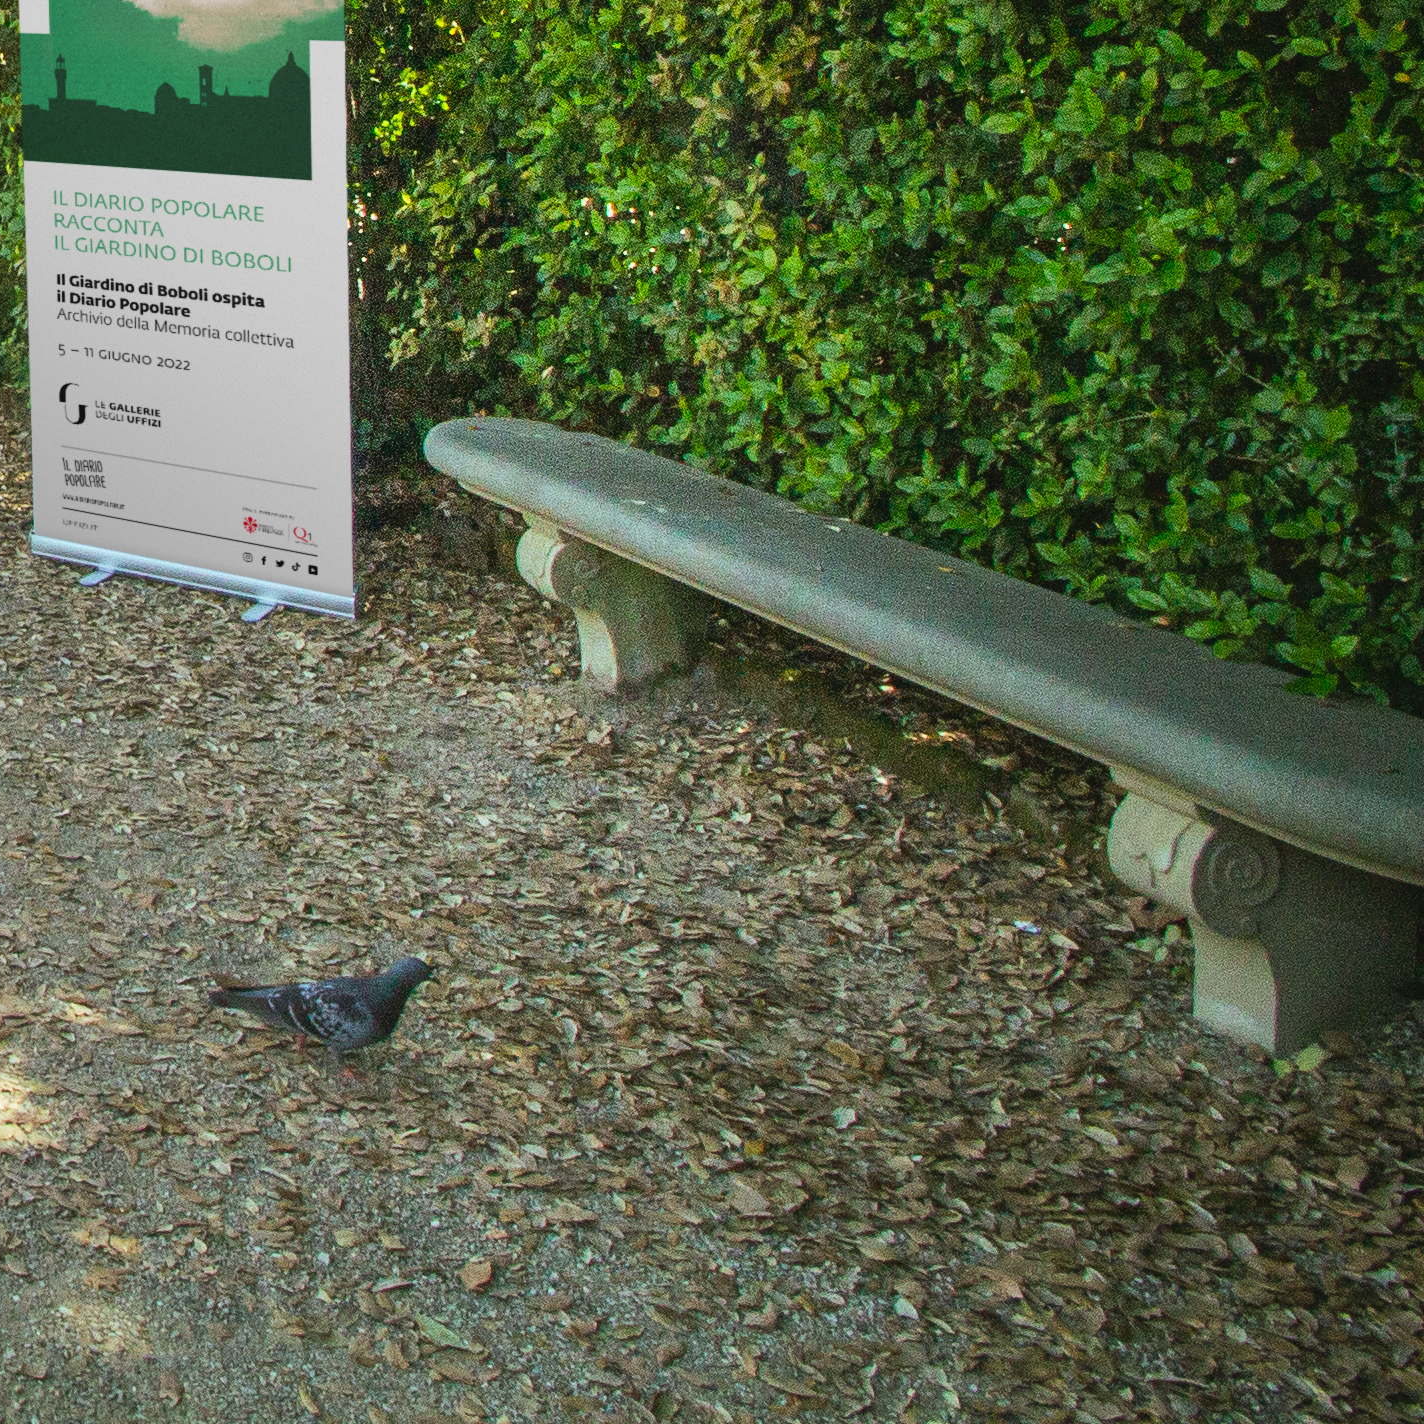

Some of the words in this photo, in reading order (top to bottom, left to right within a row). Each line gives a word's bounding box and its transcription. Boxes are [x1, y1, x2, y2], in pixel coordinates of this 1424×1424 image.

[54, 191, 68, 206] IL
[75, 192, 144, 212] DIARIO
[152, 198, 264, 222] POPOLARE
[54, 213, 164, 237] RACCONTA
[55, 235, 69, 250] IL
[75, 237, 176, 260] GIARDINO
[184, 247, 203, 263] DI
[212, 250, 291, 272] BOBOLI
[57, 274, 65, 285] Il
[70, 275, 134, 293] Giardino
[139, 282, 153, 295] di
[158, 285, 208, 301] Boboli
[212, 292, 265, 308] ospita
[57, 290, 65, 302] il
[70, 292, 115, 308] Diario
[120, 296, 190, 317] Popolare
[57, 307, 112, 325] Archivio
[117, 316, 149, 330] della
[155, 319, 220, 339] Memoria
[225, 330, 294, 348] collettiva
[59, 344, 65, 356] 5
[84, 347, 93, 357] 11
[99, 350, 152, 365] GIUGNO
[157, 357, 190, 370] 2022
[95, 401, 105, 409] LE
[109, 403, 160, 417] GALLERIE
[96, 411, 123, 421] DEGLI
[127, 416, 161, 427] UFFIZI
[62, 457, 71, 471] IL
[74, 460, 103, 472] DIARIO
[65, 474, 106, 488] POPOLARE
